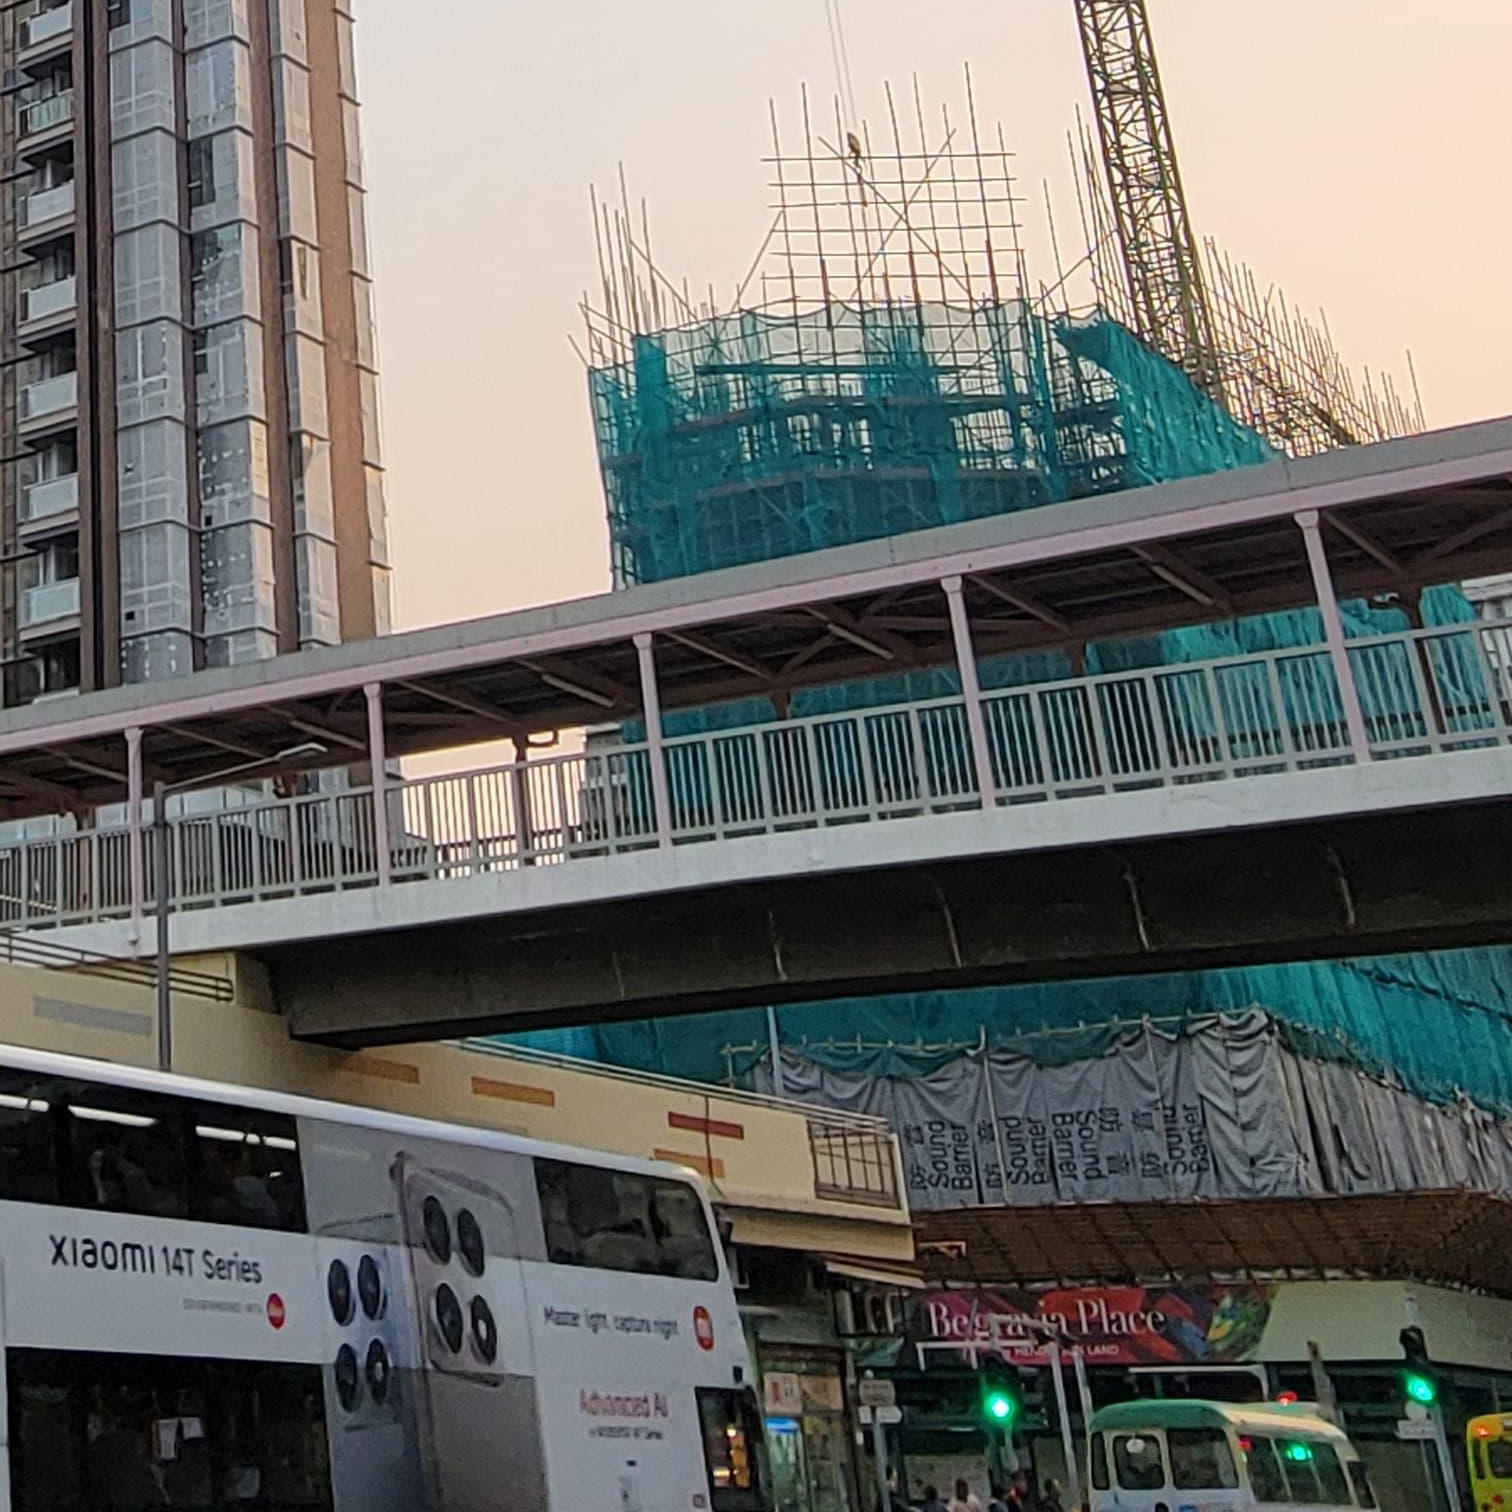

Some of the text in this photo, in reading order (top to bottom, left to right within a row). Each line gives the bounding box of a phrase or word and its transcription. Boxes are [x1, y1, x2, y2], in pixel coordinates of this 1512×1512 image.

[923, 1120, 950, 1188] Sound
[946, 1123, 973, 1190] Barrier
[998, 1115, 1031, 1185] Sound
[1026, 1116, 1050, 1185] Barrier
[1051, 1112, 1079, 1182] Barrier
[1075, 1110, 1108, 1180] Sound
[1183, 1103, 1209, 1175] Barrier
[162, 1245, 195, 1278] 14T
[201, 1249, 263, 1284] Series
[1077, 1297, 1167, 1336] Place
[1086, 1343, 1120, 1356] LAND
